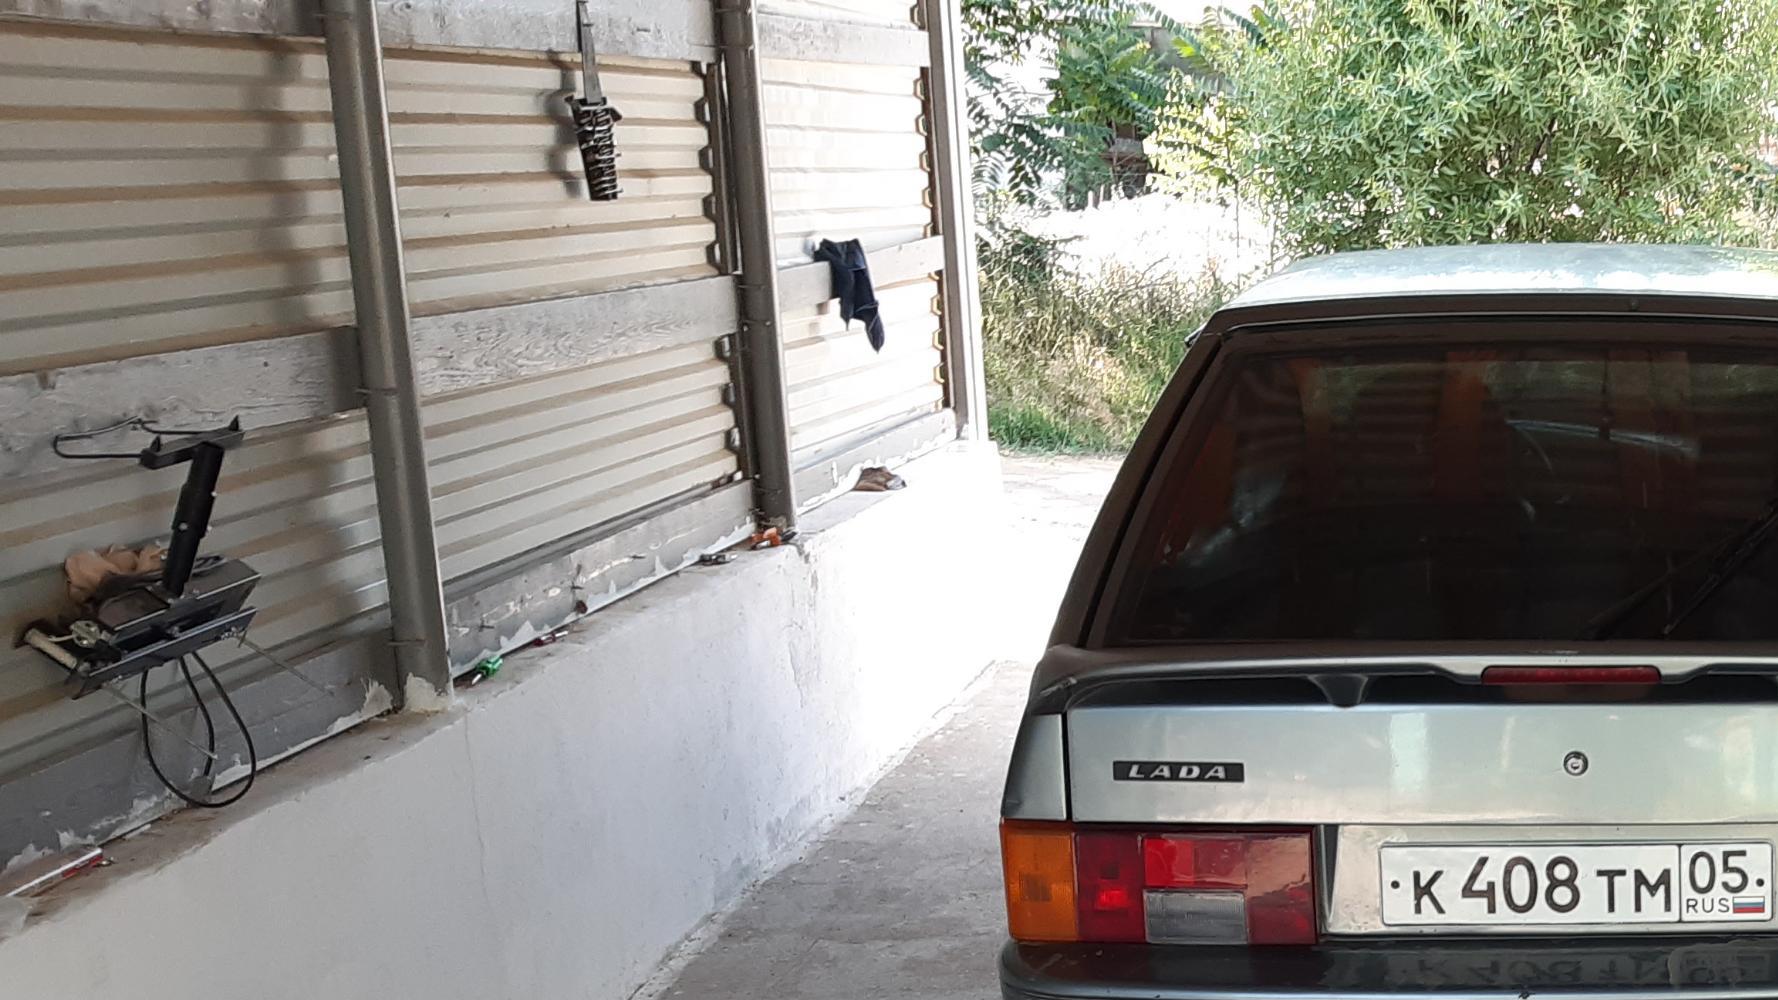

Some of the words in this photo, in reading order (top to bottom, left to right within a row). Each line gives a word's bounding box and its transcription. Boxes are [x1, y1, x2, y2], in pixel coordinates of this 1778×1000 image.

[1128, 764, 1226, 779] LADA
[1688, 849, 1749, 894] 05
[1686, 897, 1731, 914] RUS
